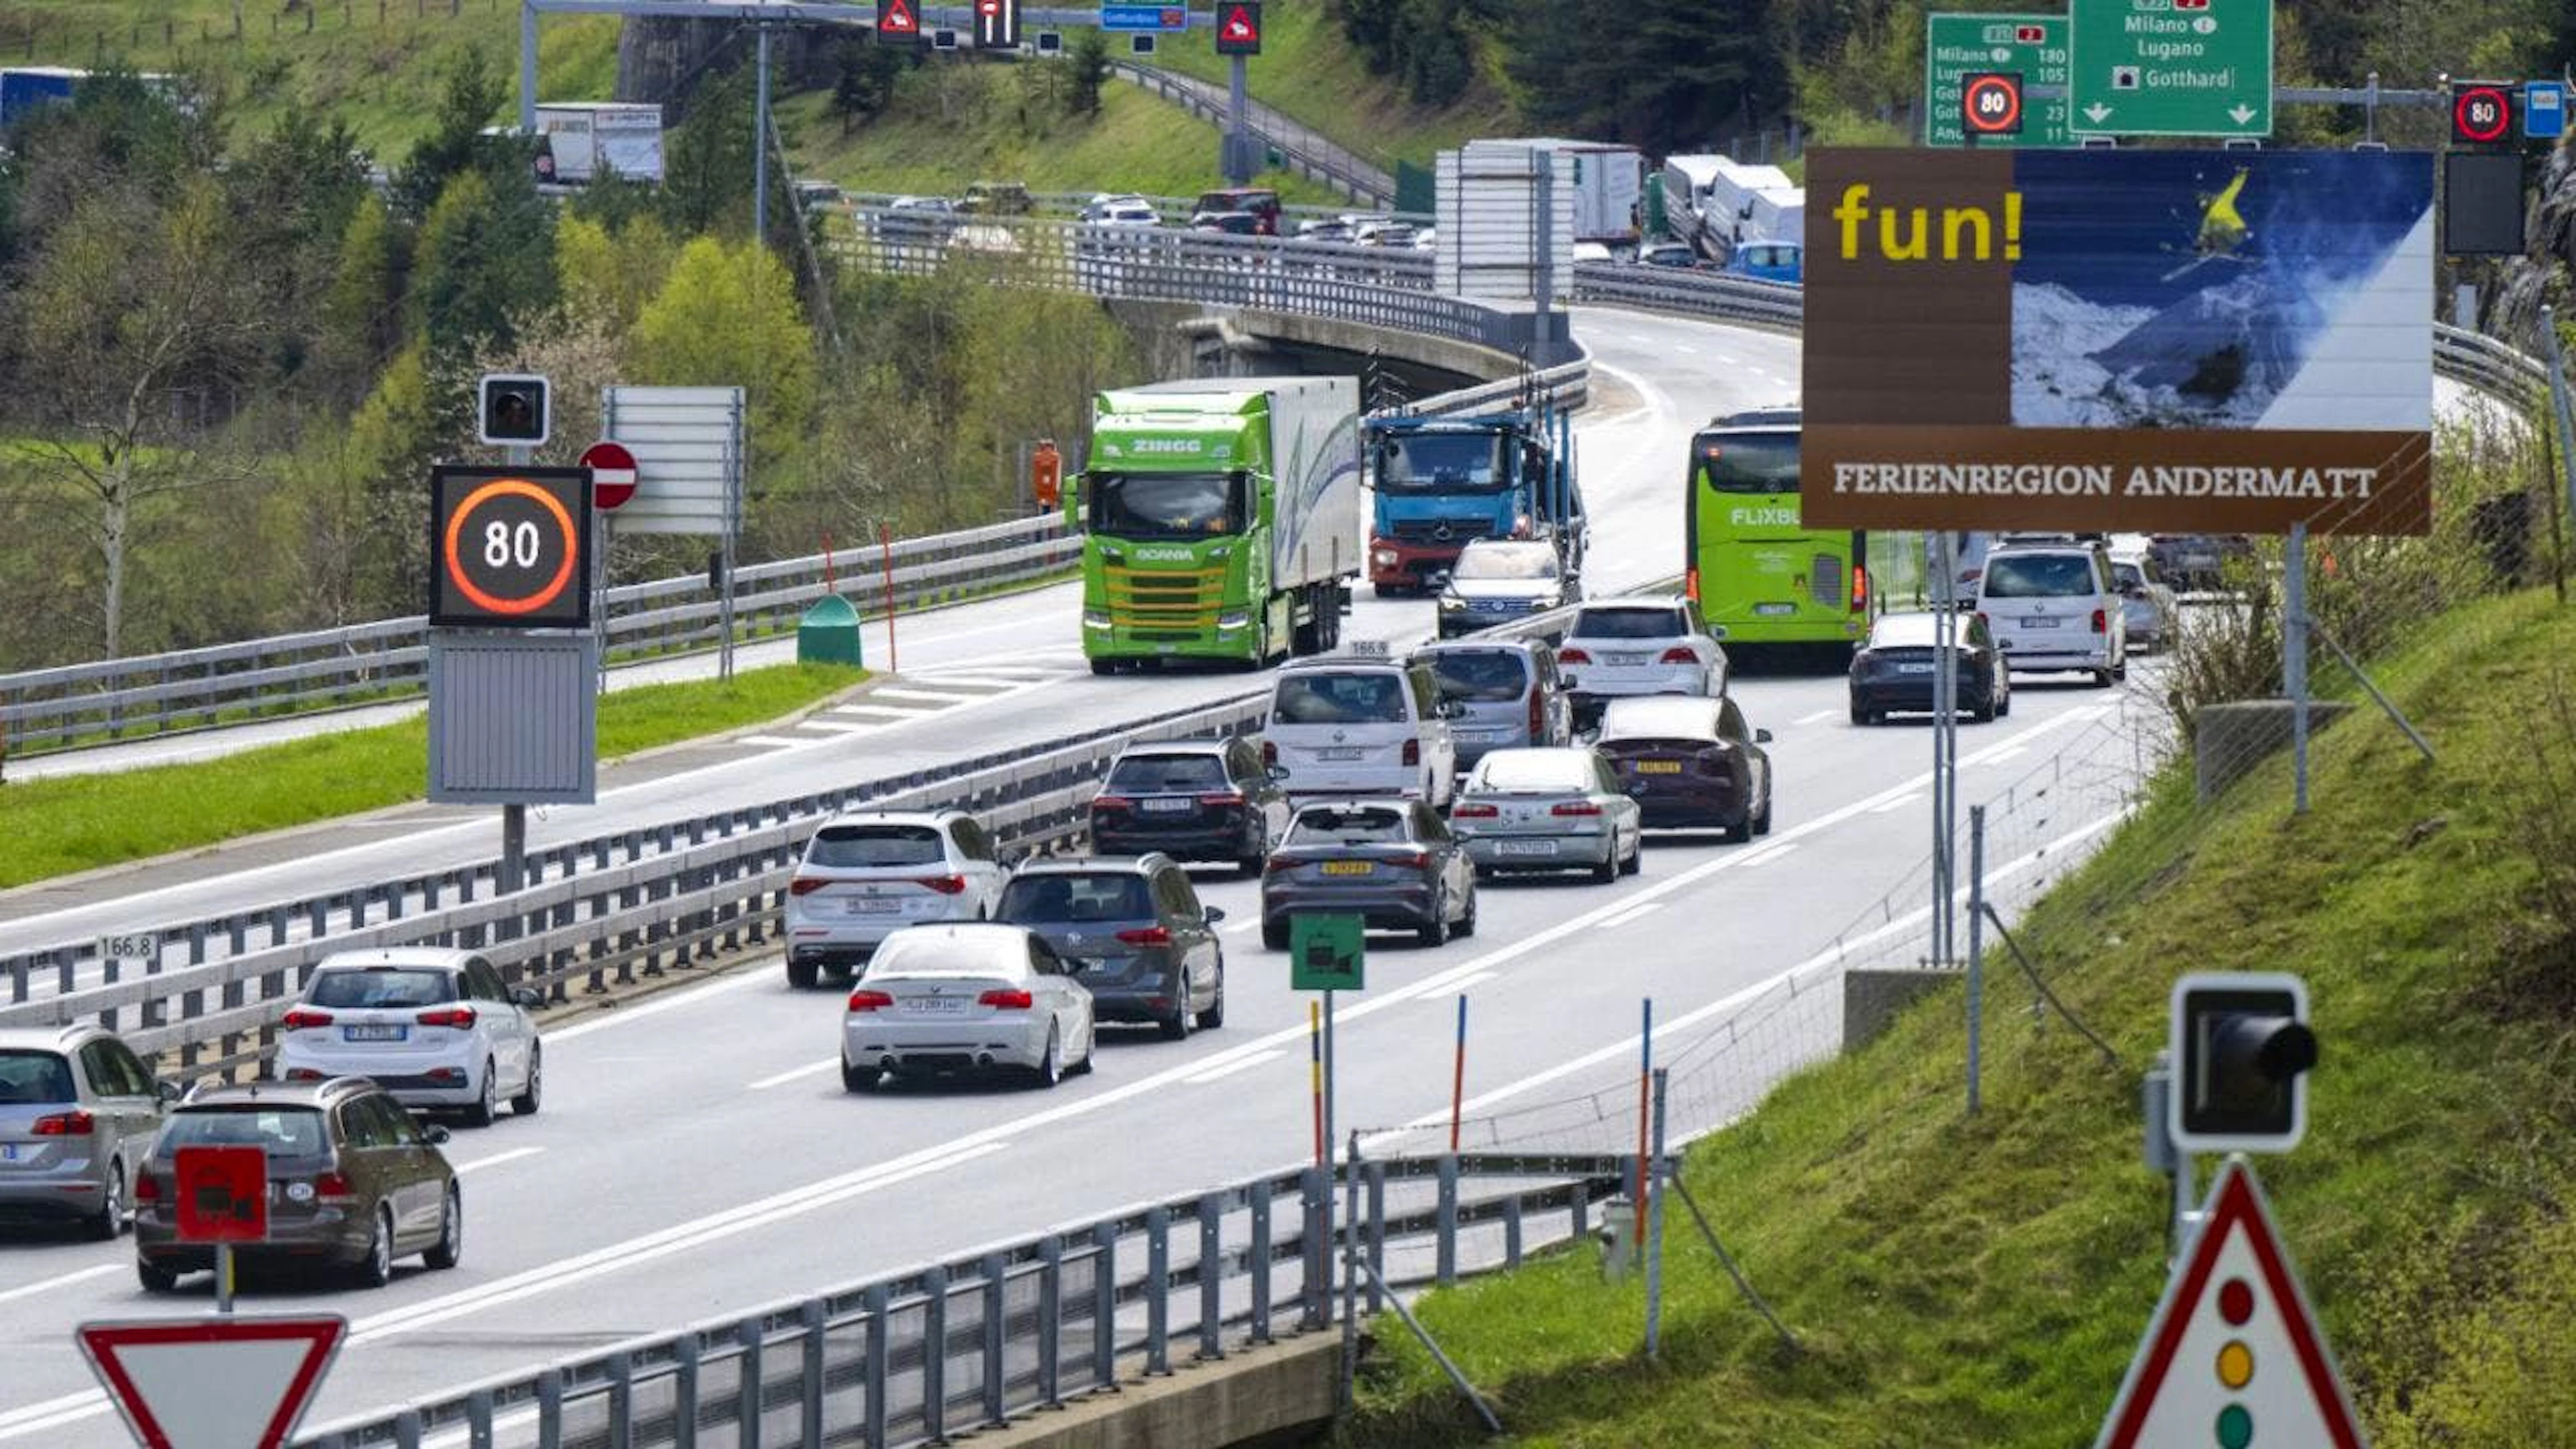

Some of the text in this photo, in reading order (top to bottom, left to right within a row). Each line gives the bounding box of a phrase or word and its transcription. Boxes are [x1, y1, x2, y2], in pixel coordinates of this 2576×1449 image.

[2125, 15, 2188, 32] Milano
[1936, 47, 1989, 62] Milano
[2039, 49, 2066, 63] 180
[2137, 39, 2205, 60] Lugano
[2146, 68, 2230, 88] Gotthard
[1980, 92, 2006, 113] 80
[2047, 107, 2064, 121] 23
[2472, 103, 2495, 123] 80
[2047, 128, 2062, 141] 11
[1833, 182, 2022, 260] fun!
[1134, 439, 1201, 452] ZINGG
[1833, 463, 2377, 498] FERIENREGION ANDERMATT
[484, 521, 539, 568] 80
[102, 936, 150, 957] 166.8
